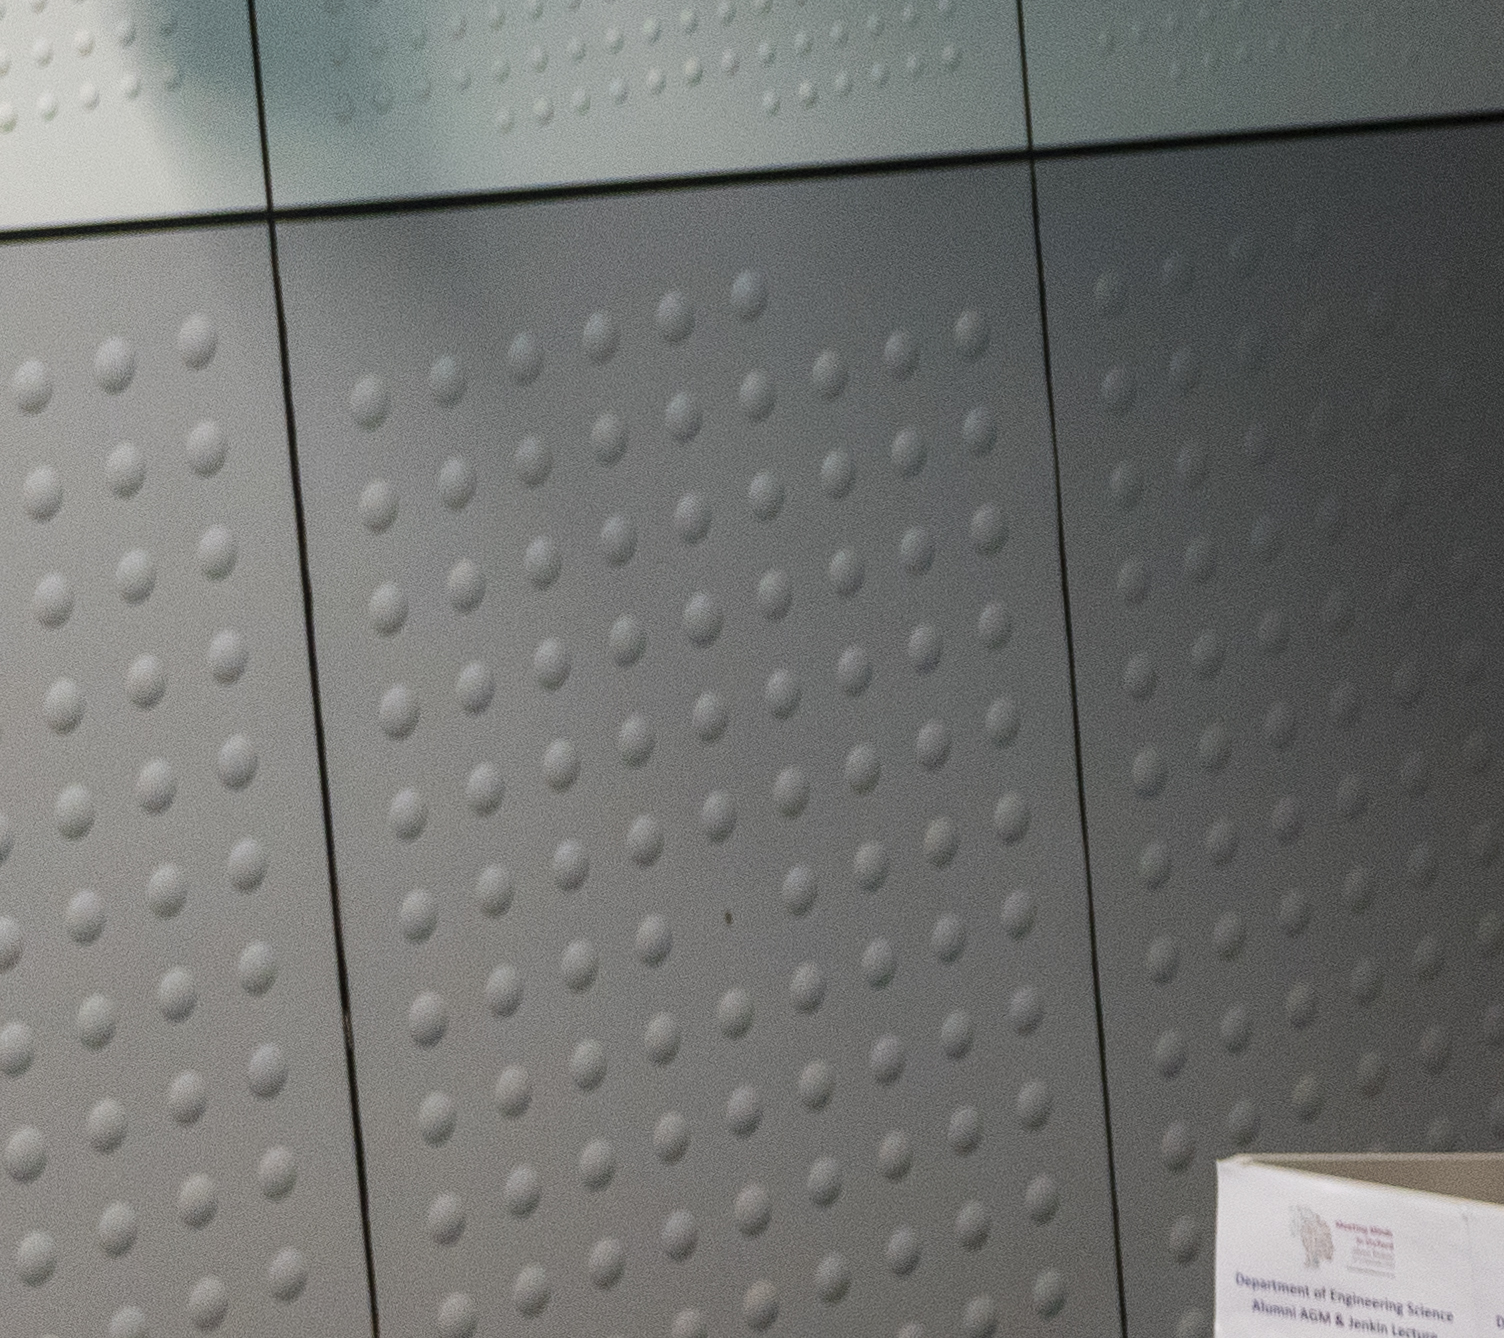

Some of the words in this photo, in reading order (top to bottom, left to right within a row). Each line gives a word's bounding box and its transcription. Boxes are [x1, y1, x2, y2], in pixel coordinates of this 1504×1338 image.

[1236, 1272, 1309, 1298] Department
[1314, 1286, 1326, 1299] of
[1330, 1288, 1403, 1316] Engineering
[1407, 1300, 1454, 1323] Science
[1252, 1299, 1297, 1319] Alumni
[1300, 1307, 1331, 1325] AGM
[1335, 1315, 1344, 1327] &
[1349, 1316, 1388, 1335] Jenkin
